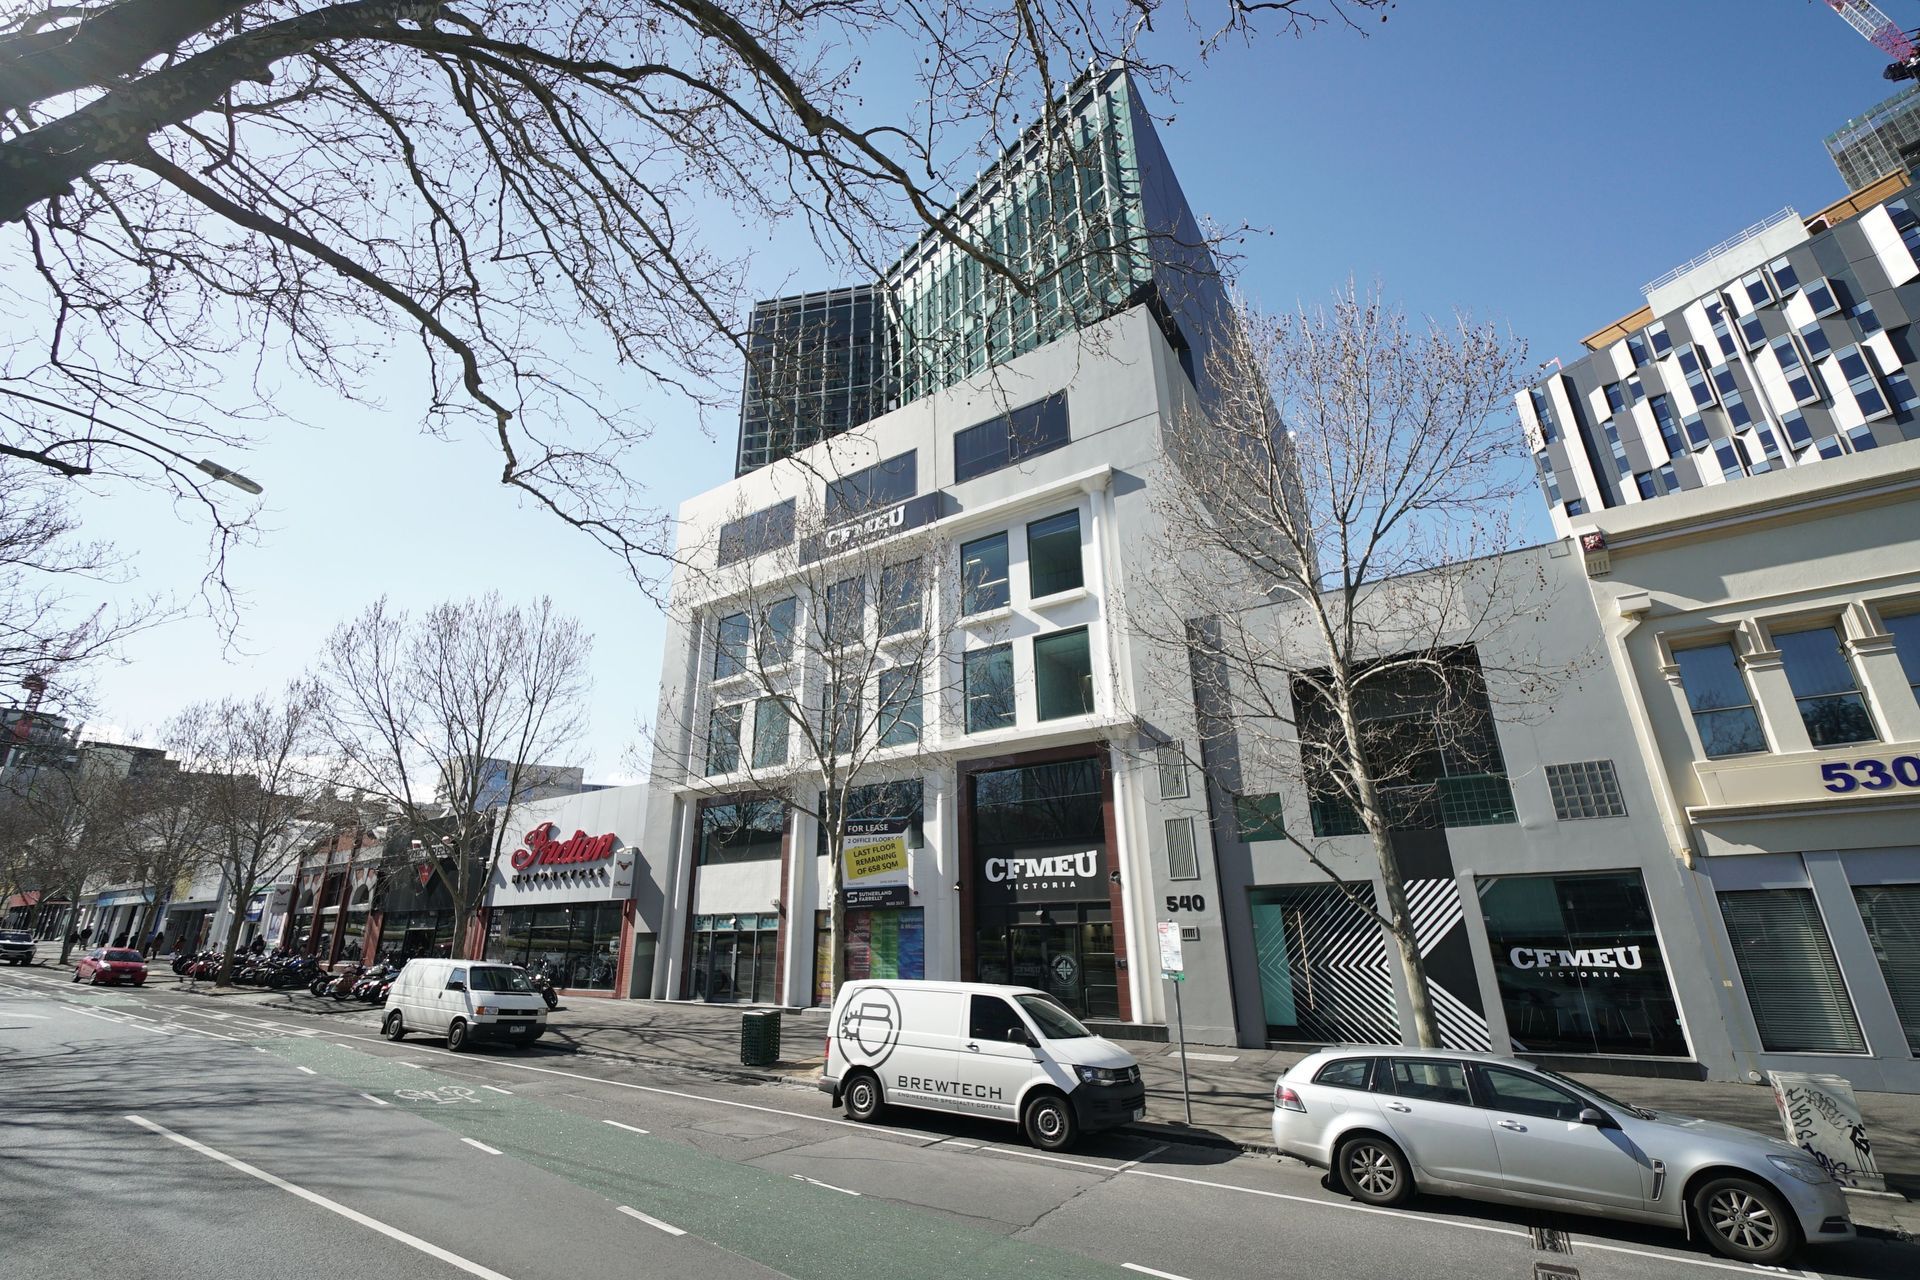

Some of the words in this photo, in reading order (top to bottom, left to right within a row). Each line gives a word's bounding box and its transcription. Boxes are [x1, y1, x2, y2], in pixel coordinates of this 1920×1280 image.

[825, 505, 905, 548] CFMEU
[1820, 756, 1920, 793] 530
[866, 824, 888, 832] LEASE
[511, 822, 615, 871] Indian
[854, 849, 871, 857] LAST
[873, 843, 896, 851] FLOOR
[856, 853, 896, 866] REMAINING
[857, 867, 867, 875] OF
[868, 865, 881, 873] 658
[883, 861, 898, 869] SQM
[985, 850, 1097, 882] CFMEU
[512, 867, 605, 884] MOTORCYCLE
[1006, 881, 1077, 890] VICTORIA
[1166, 895, 1205, 912] 540
[1510, 945, 1642, 969] CFMEU
[898, 1075, 1002, 1100] BREWTECH
[897, 1092, 938, 1102] ENGINEERING
[941, 1098, 975, 1107] SPECIALTY
